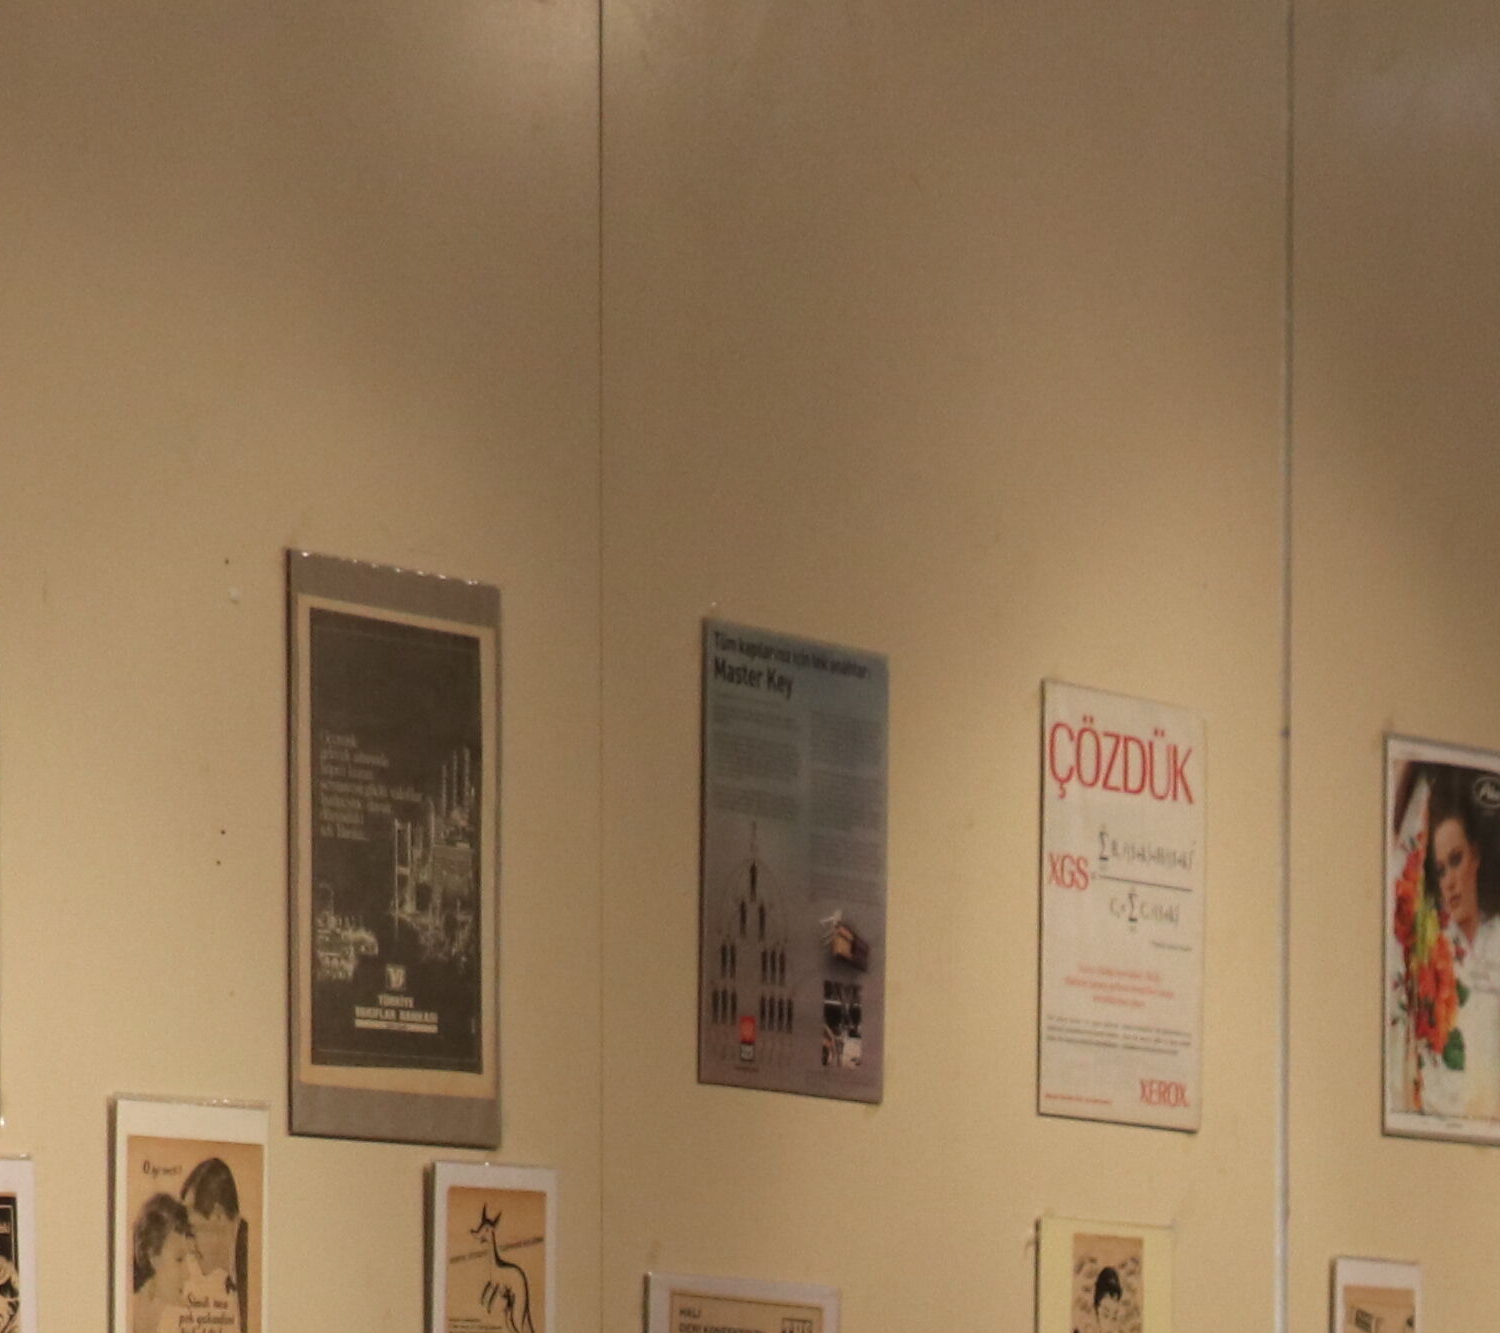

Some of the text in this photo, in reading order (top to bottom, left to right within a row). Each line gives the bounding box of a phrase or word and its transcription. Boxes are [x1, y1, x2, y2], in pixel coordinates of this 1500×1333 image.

[714, 656, 794, 701] Master Key
[1050, 714, 1194, 804] ÇÖZDÜK
[1049, 853, 1089, 891] XGS
